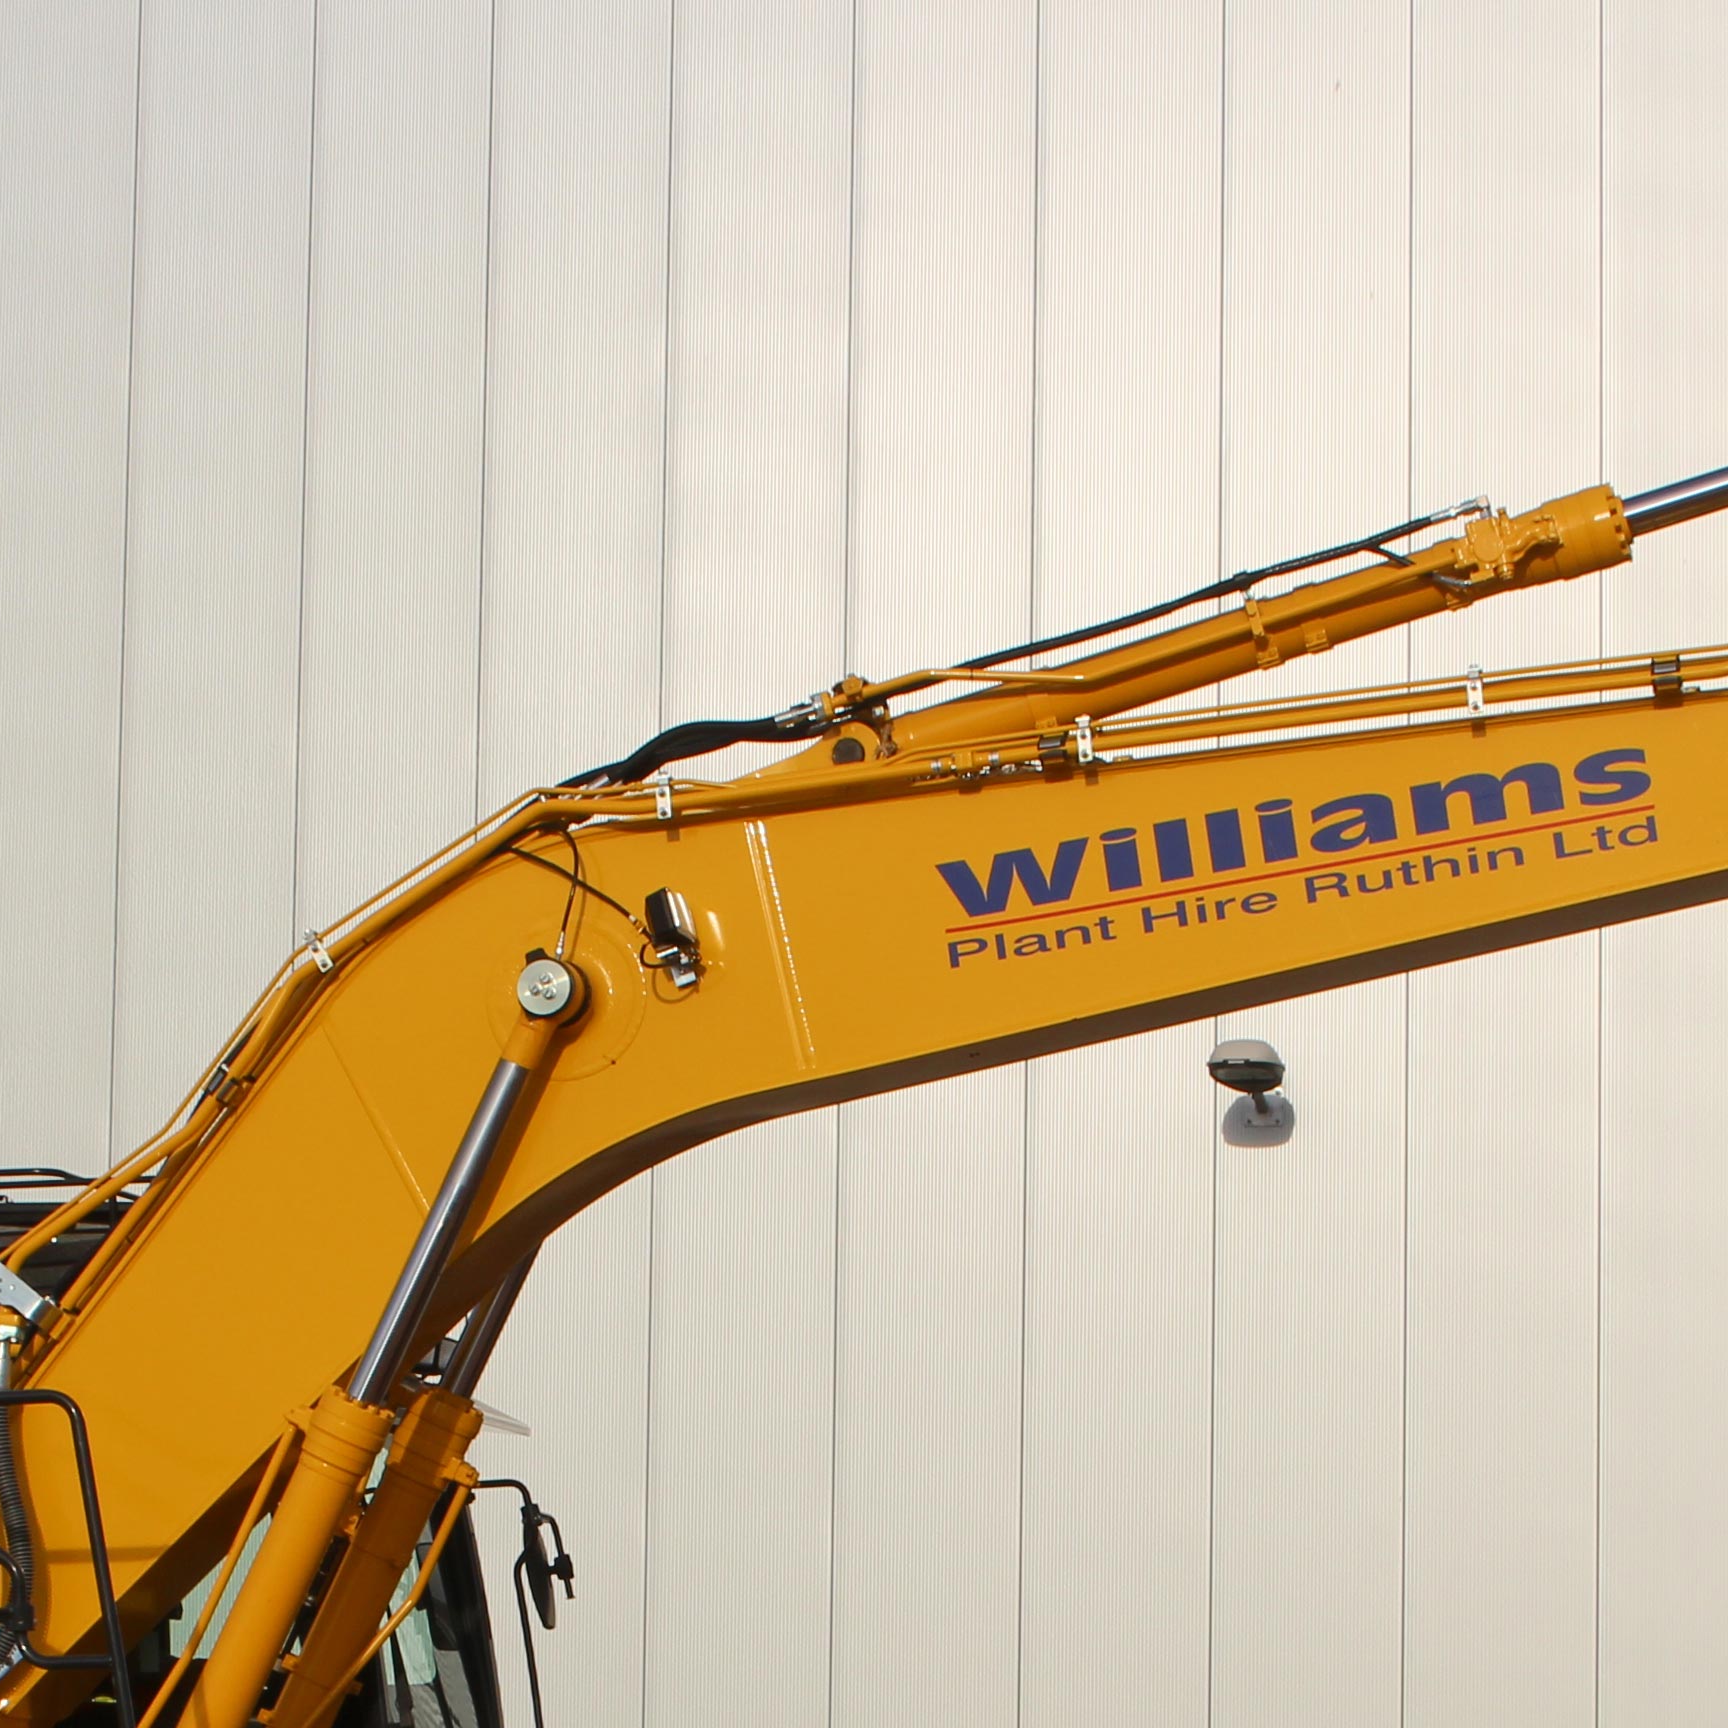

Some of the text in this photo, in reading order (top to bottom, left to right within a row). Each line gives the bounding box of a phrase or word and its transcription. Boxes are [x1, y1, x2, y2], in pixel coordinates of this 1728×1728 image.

[935, 748, 1652, 917] Williams
[947, 816, 1658, 968] Plant Hire Ruthin Ltd
